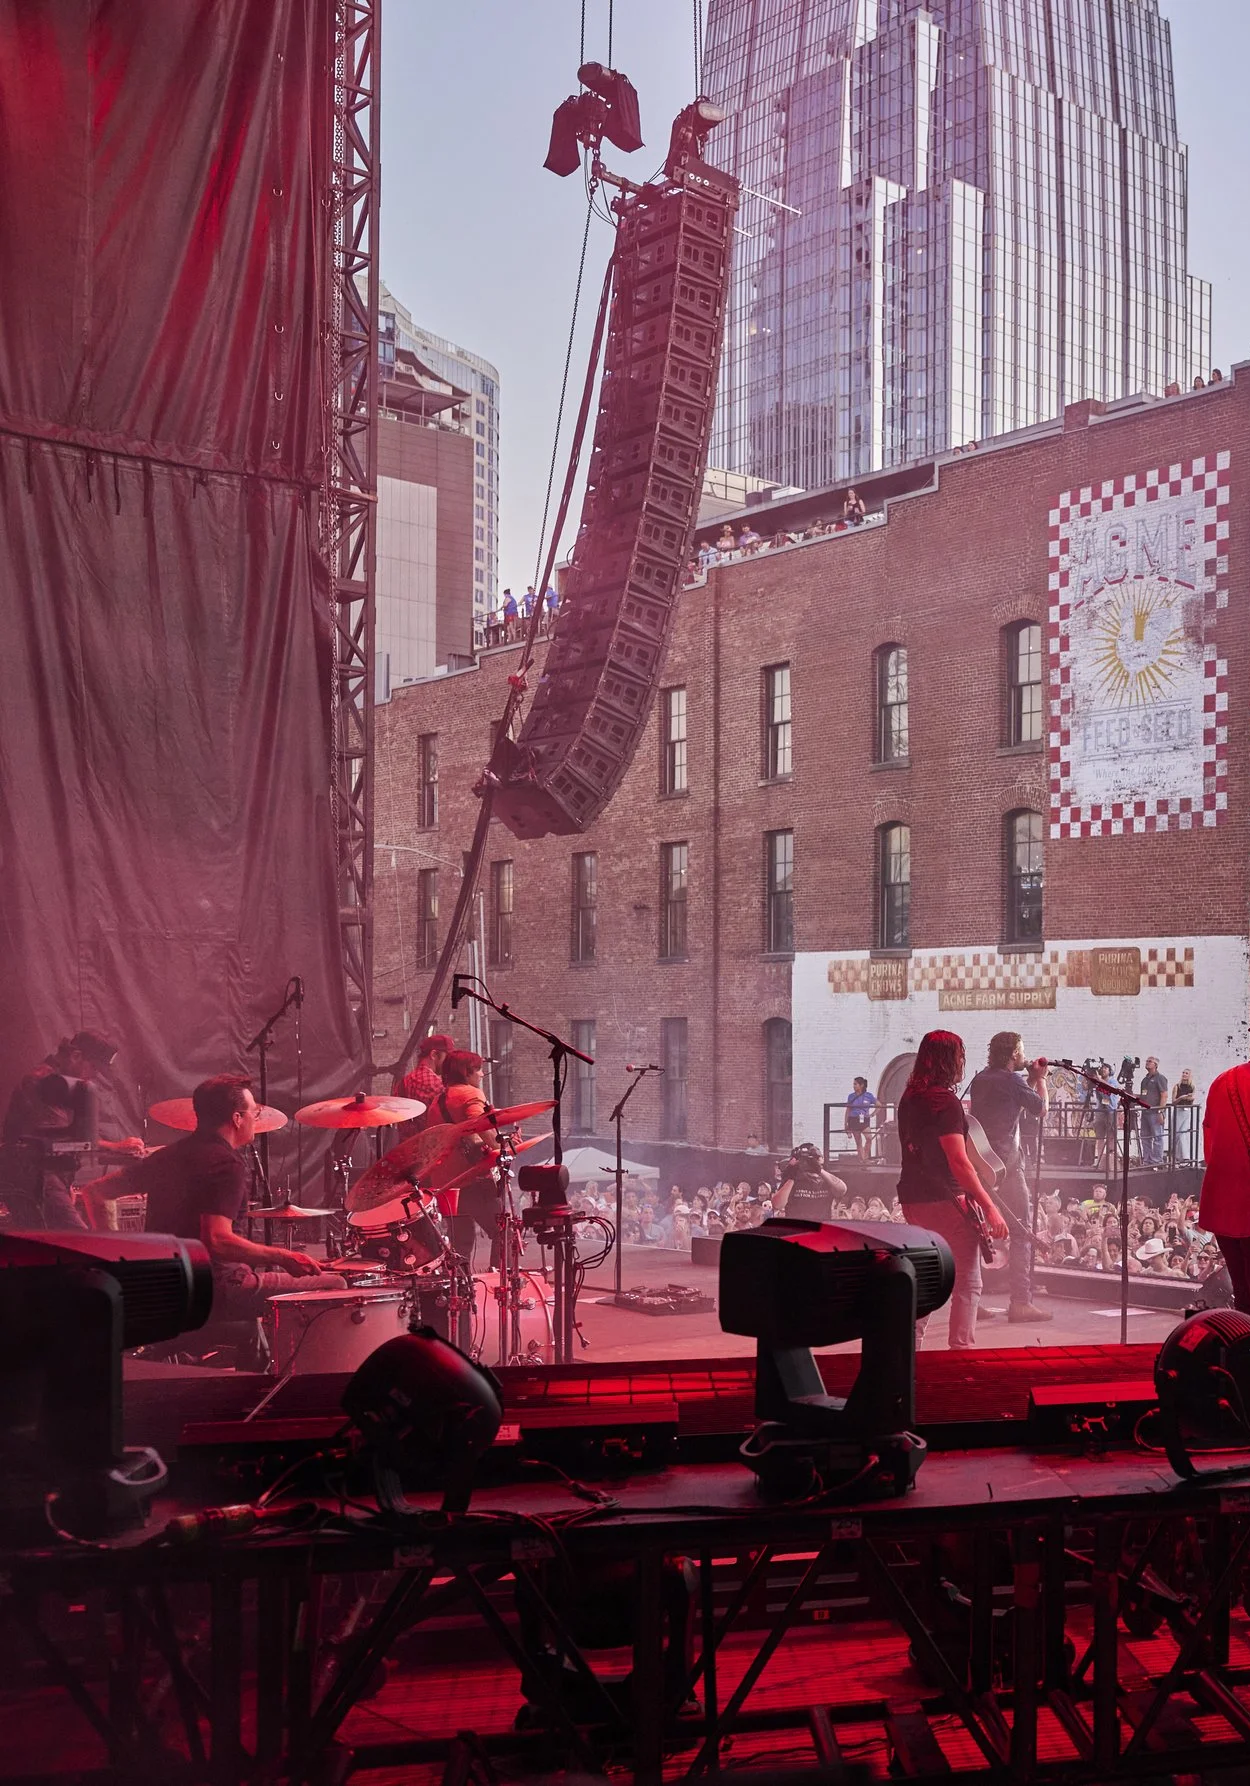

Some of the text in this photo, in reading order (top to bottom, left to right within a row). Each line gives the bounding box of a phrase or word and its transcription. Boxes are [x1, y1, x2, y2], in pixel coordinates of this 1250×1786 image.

[1073, 508, 1197, 599] ACME
[1082, 717, 1131, 752] FEED
[1140, 709, 1192, 744] SEED
[1098, 952, 1134, 965] PURINA
[870, 963, 904, 978] PURINA
[871, 979, 902, 993] CHOWS
[942, 991, 1052, 1007] ACME FARM SUPPLY
